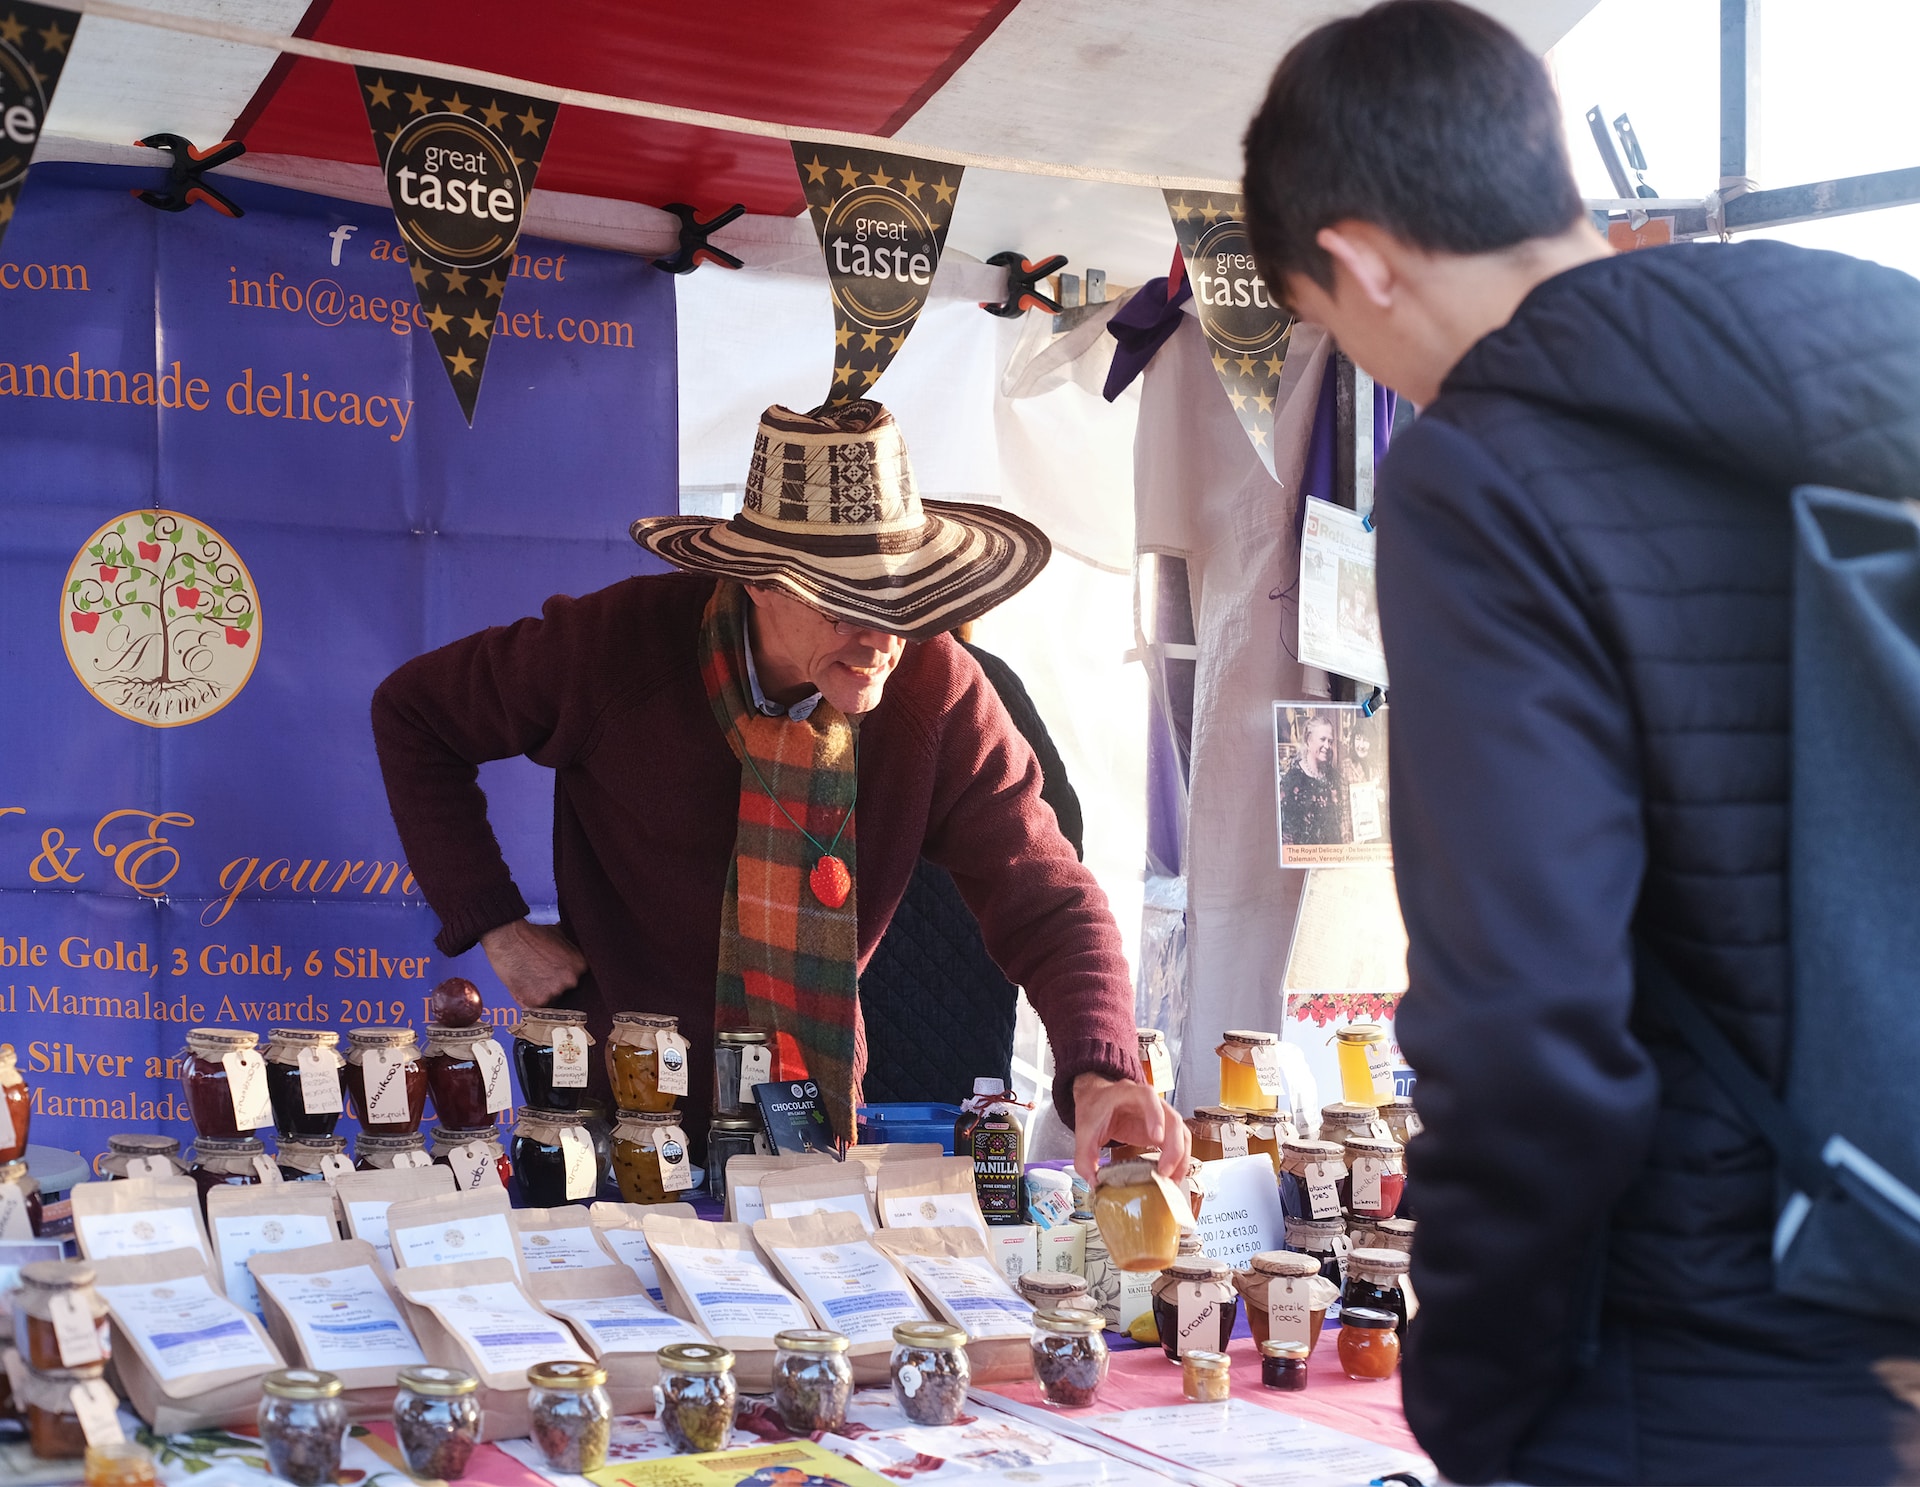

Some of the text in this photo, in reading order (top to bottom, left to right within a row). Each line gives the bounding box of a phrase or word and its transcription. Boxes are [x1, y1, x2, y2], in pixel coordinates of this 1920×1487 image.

[424, 146, 487, 176] great
[396, 165, 515, 223] taste
[855, 217, 908, 242] great
[832, 236, 931, 285] taste
[1216, 252, 1257, 275] grea
[226, 367, 415, 442] delicacy
[29, 827, 85, 883] &
[93, 809, 195, 897] E
[58, 936, 158, 979] Gold,
[171, 948, 189, 976] 3
[199, 943, 292, 981] Gold,
[304, 949, 323, 977] 6
[334, 947, 430, 979] Silver
[27, 985, 205, 1023] Marmalade
[215, 994, 329, 1023] Awards
[339, 999, 413, 1028] 2019,
[28, 1041, 133, 1078] Silver
[370, 1063, 402, 1109] abrikoos
[771, 1101, 816, 1112] CHOCOLATE
[974, 1161, 1019, 1173] VANILLA
[1215, 1209, 1249, 1223] HONING
[1220, 1230, 1225, 1239] 2
[1233, 1224, 1258, 1237] €13,00
[1223, 1246, 1229, 1256] 2
[1236, 1241, 1262, 1254] €15,00
[1271, 1302, 1305, 1316] perzik
[1276, 1314, 1302, 1324] roos
